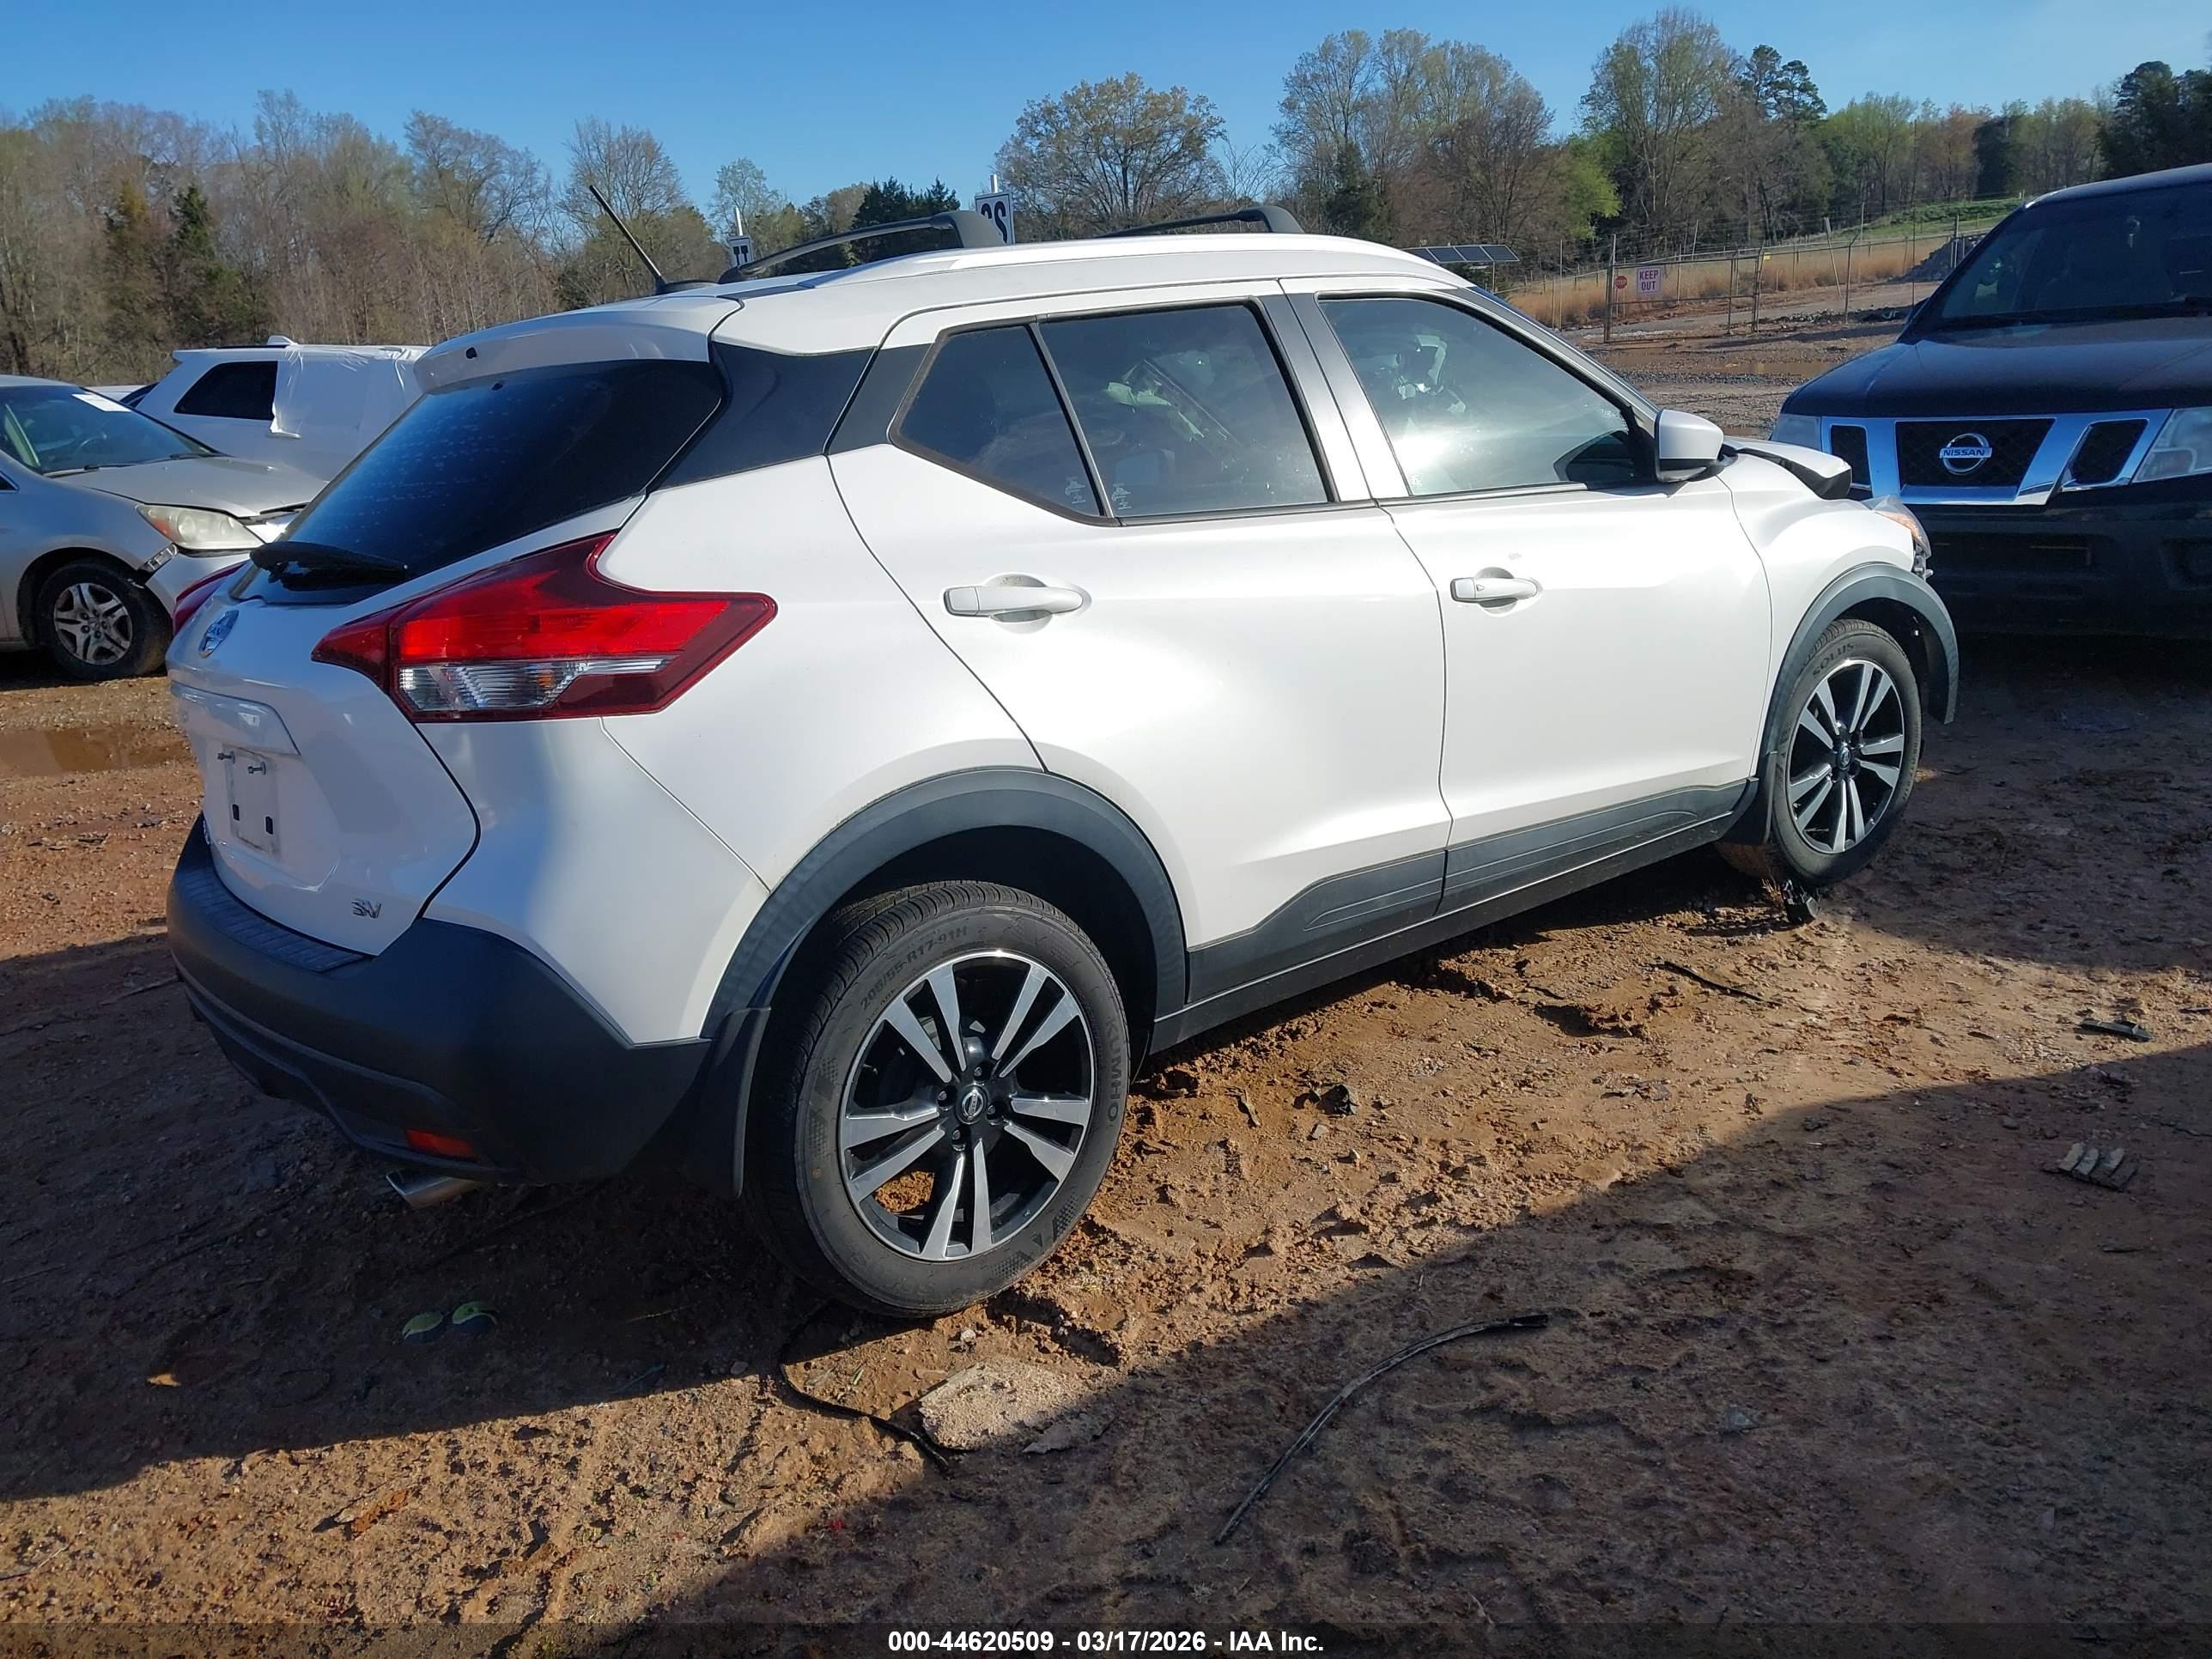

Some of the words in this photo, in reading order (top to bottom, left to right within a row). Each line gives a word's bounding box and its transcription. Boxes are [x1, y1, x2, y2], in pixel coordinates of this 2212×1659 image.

[1639, 270, 1658, 280] KEEP
[1641, 281, 1656, 291] OUT
[1813, 643, 1856, 676] SOLUS
[351, 898, 381, 919] SV
[1106, 1016, 1121, 1121] KUMHO
